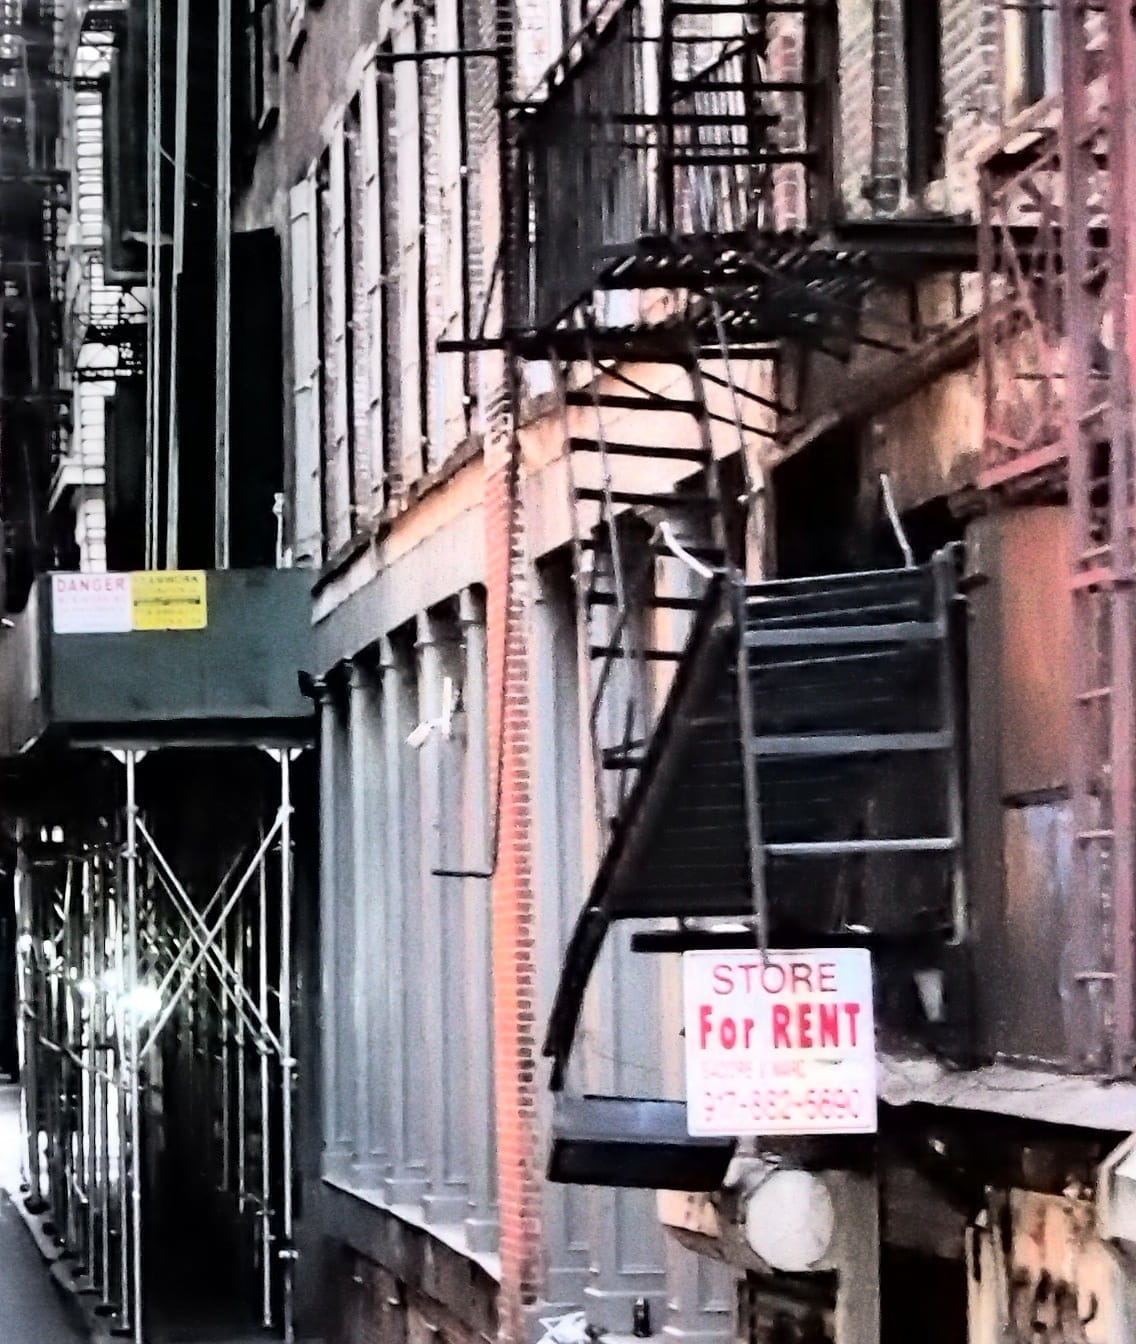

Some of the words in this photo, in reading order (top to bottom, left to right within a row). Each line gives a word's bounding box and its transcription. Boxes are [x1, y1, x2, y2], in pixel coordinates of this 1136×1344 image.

[57, 577, 125, 592] DANGER
[713, 963, 838, 995] STORE
[699, 1004, 755, 1049] For
[772, 1003, 861, 1048] RENT
